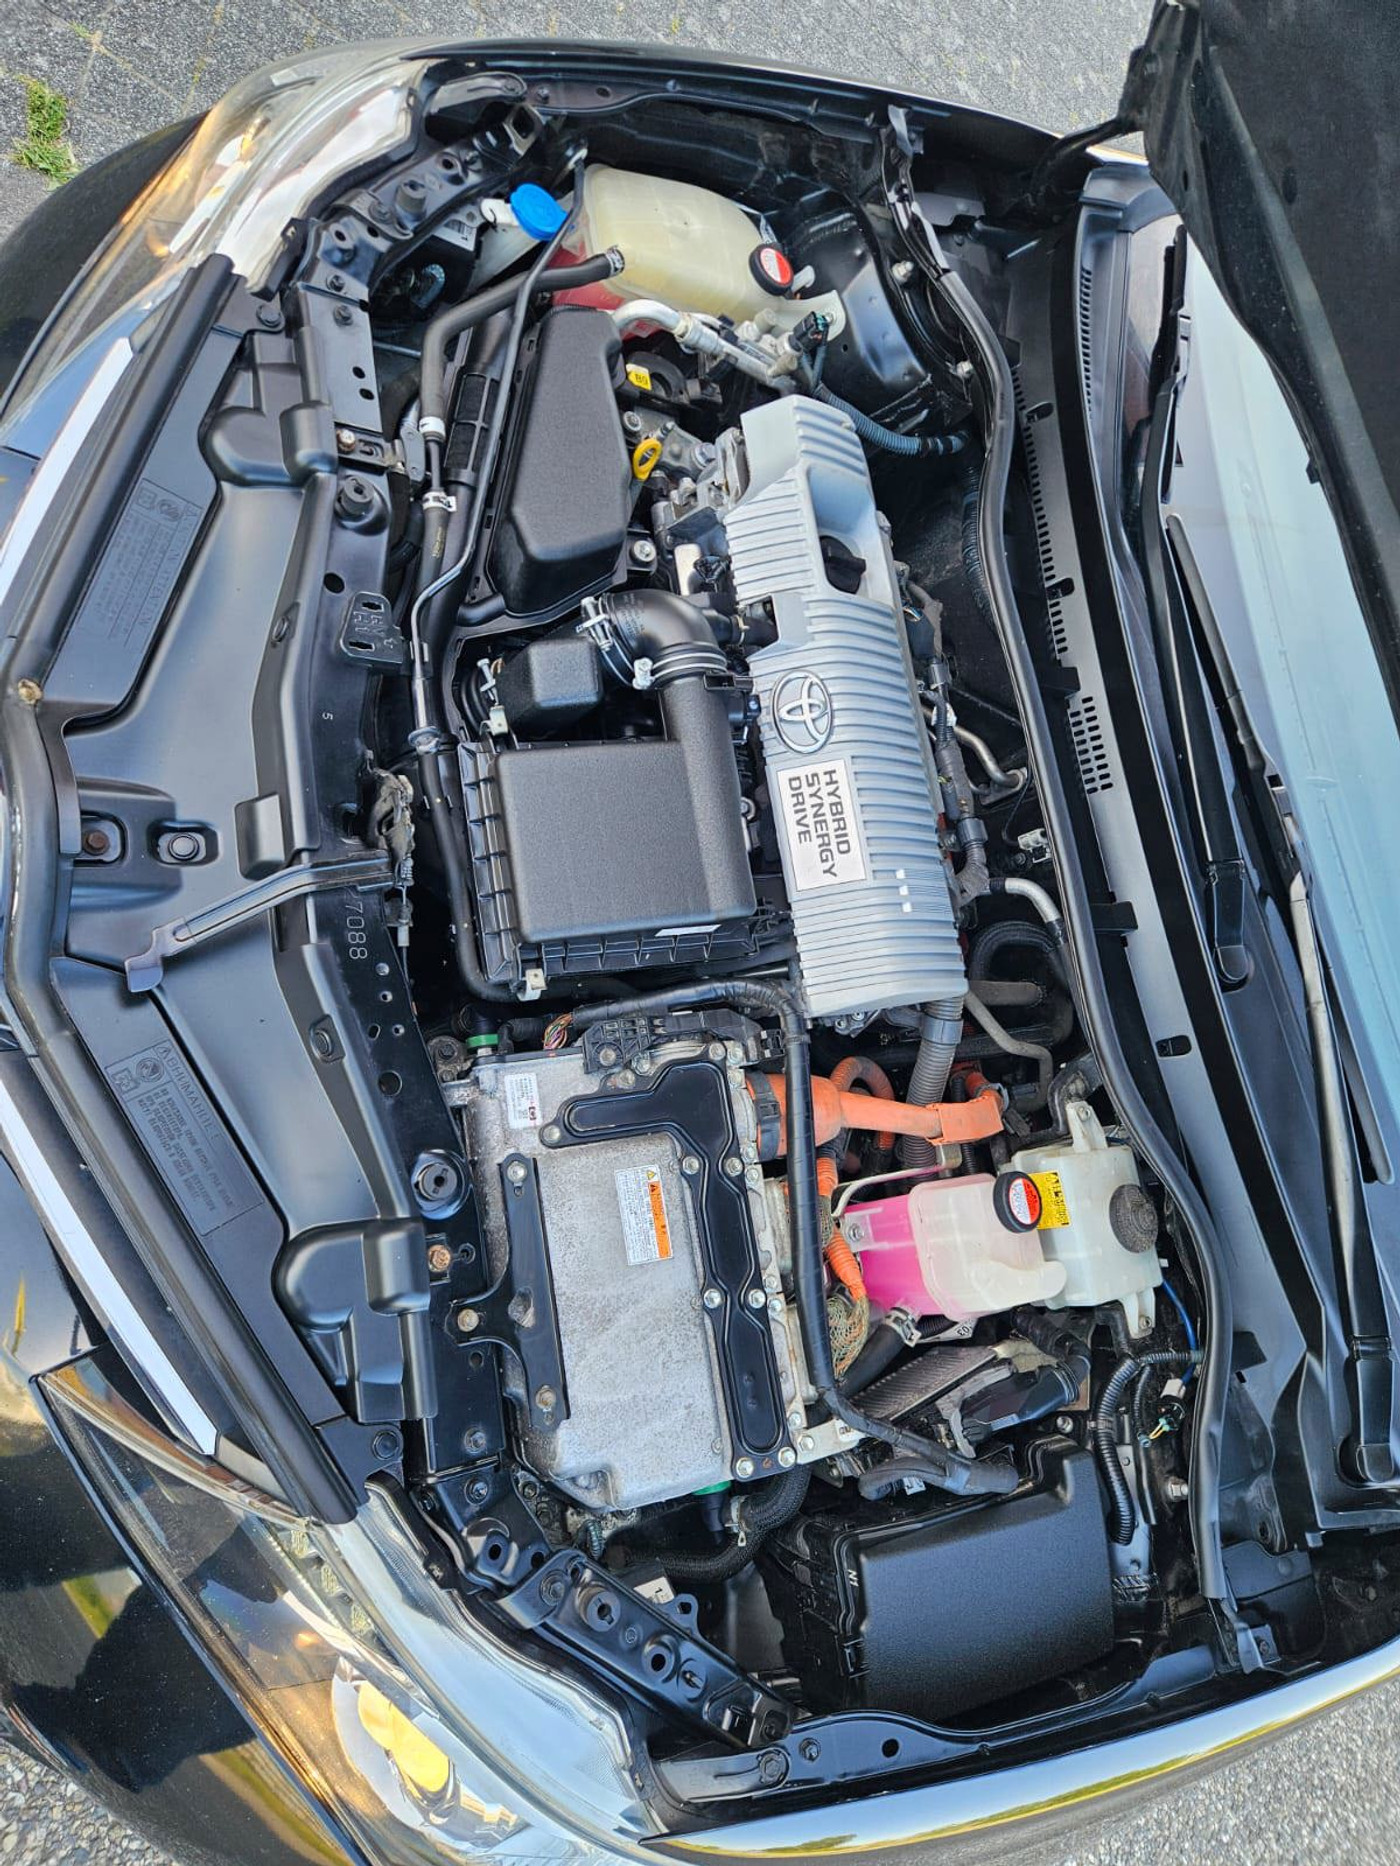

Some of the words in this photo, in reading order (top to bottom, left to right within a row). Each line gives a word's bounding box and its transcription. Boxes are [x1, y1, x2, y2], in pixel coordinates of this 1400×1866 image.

[788, 776, 812, 844] DRIVE
[805, 772, 837, 877] SYNERGY
[823, 769, 851, 855] HYBRID
